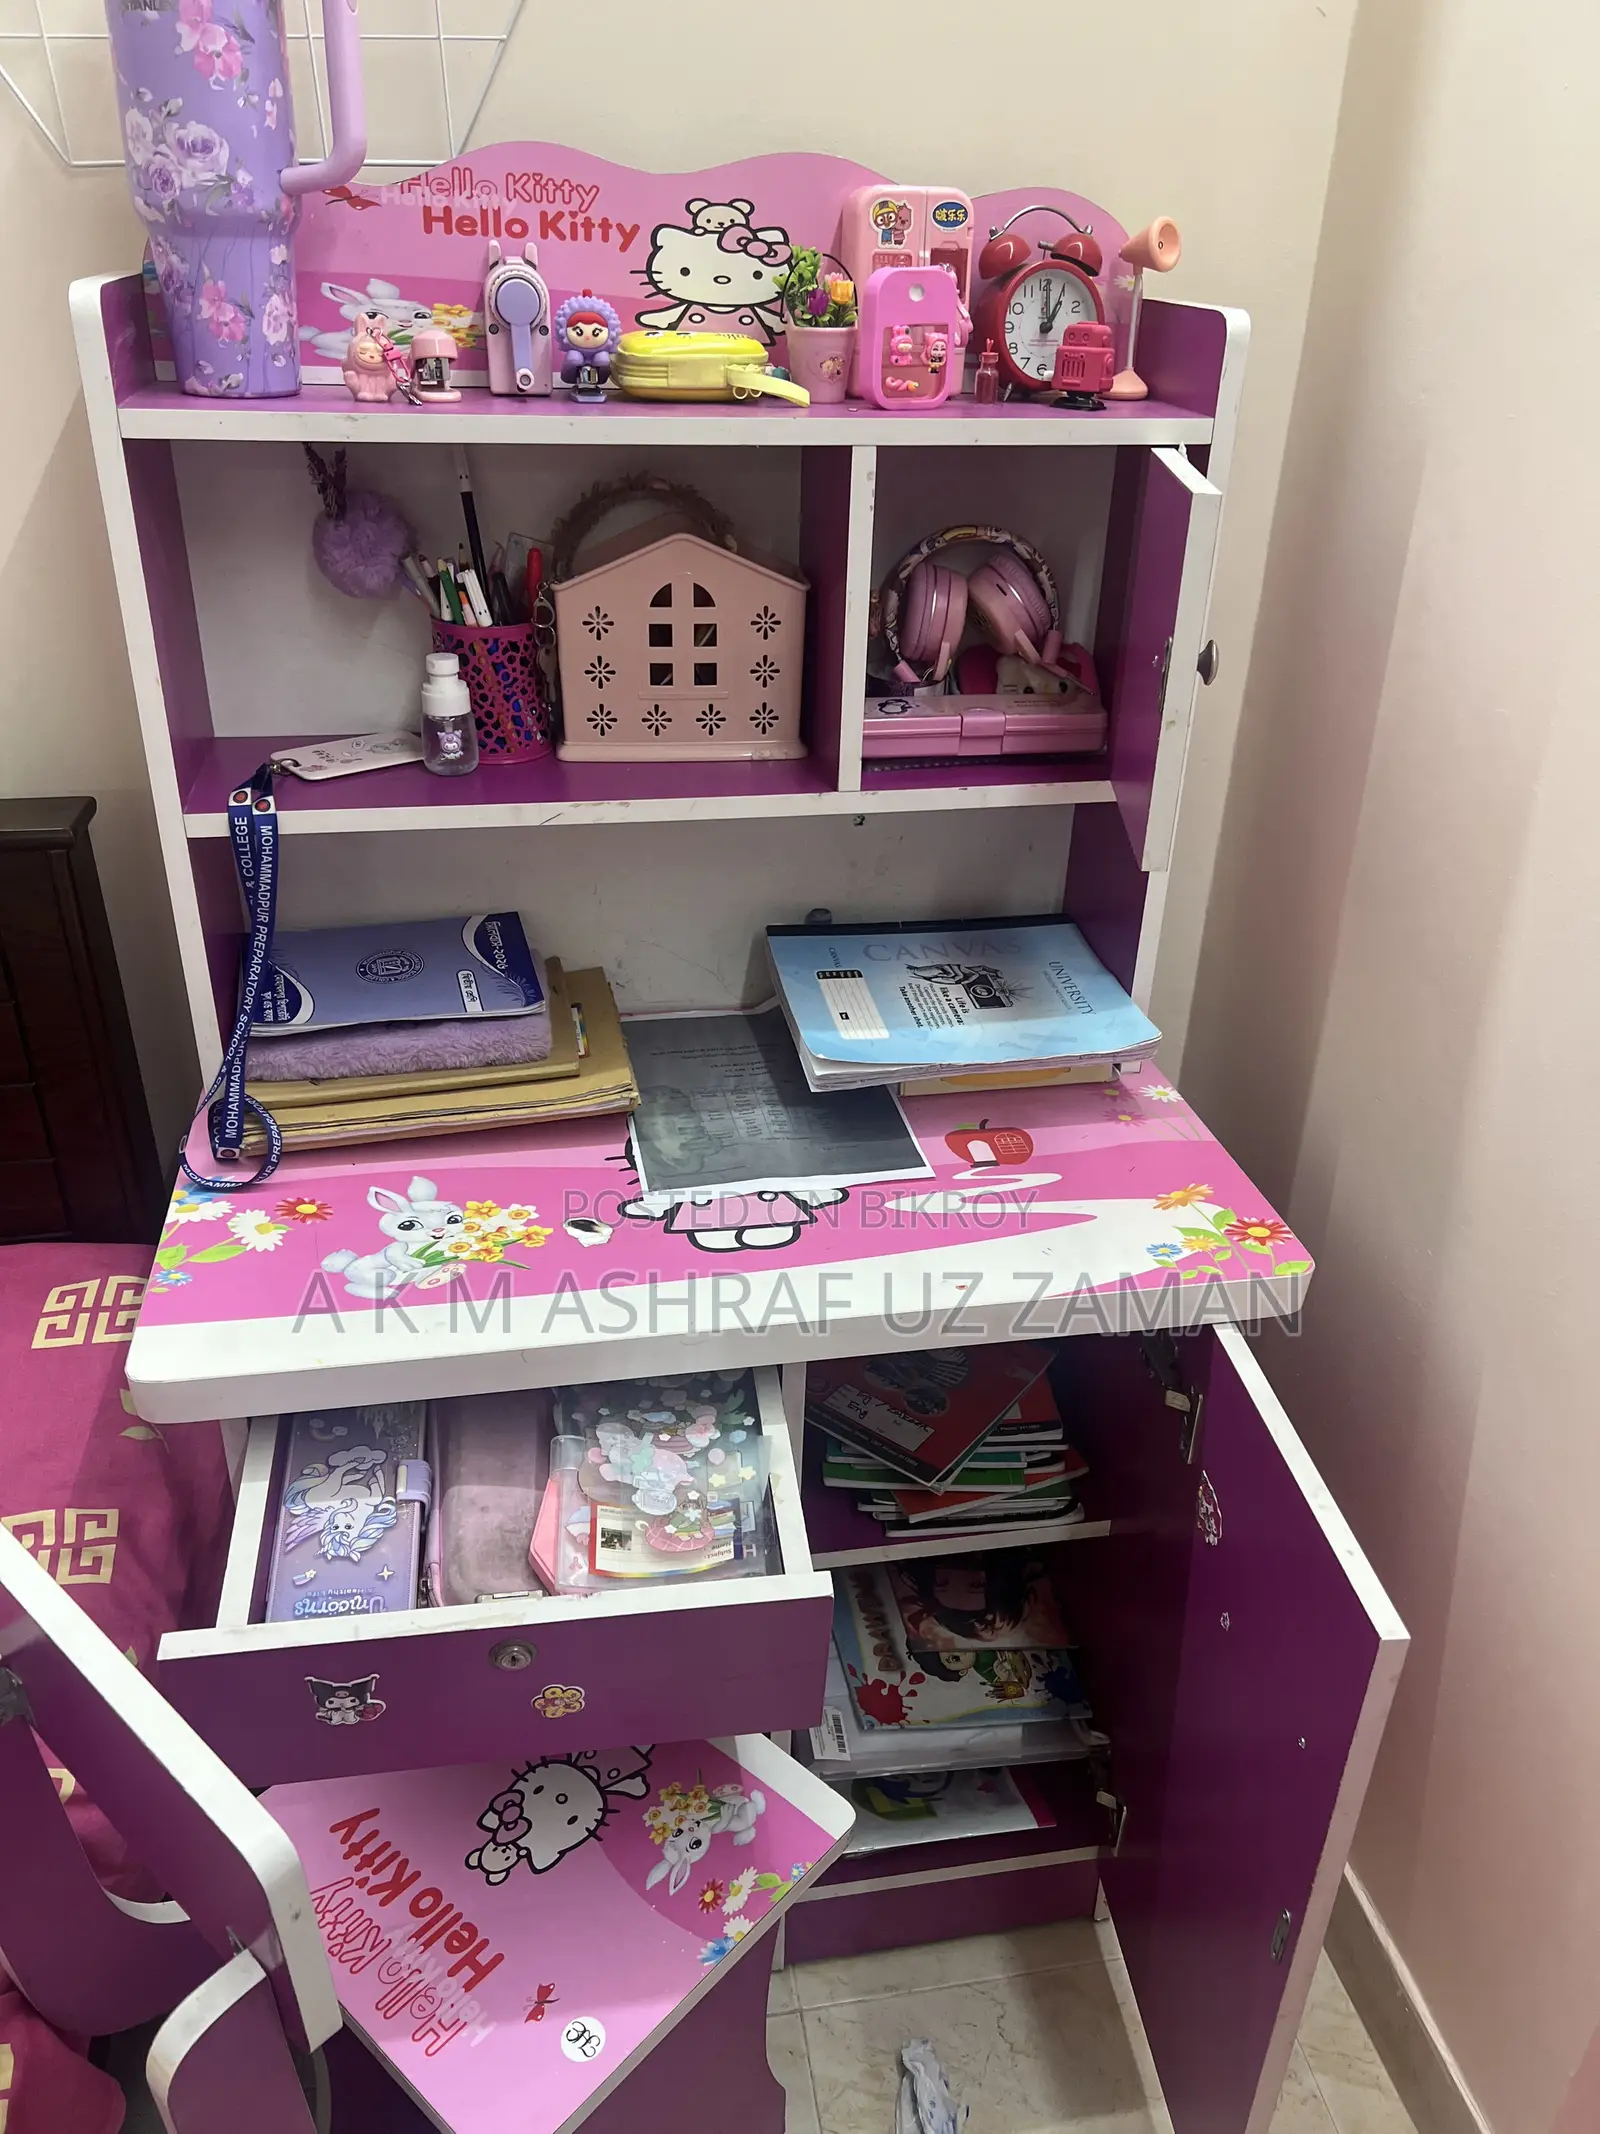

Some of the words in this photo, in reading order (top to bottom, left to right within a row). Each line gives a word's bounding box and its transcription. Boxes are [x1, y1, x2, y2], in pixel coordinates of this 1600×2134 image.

[401, 167, 498, 200] Hello
[505, 172, 600, 213] Kitty
[422, 205, 529, 239] Hello
[539, 210, 641, 253] Kitty
[1008, 302, 1024, 315] 10
[1023, 285, 1034, 298] 11
[1071, 300, 1081, 313] 2
[1004, 321, 1015, 333] 9
[1008, 342, 1019, 355] 8
[1020, 357, 1031, 370] 7
[234, 816, 255, 877] COLLEGE
[257, 825, 273, 923] MOHAMMADPUR
[243, 925, 268, 1013] PREPARATORY
[862, 936, 1022, 962] CANVAS
[899, 986, 909, 997] Take
[903, 997, 918, 1016] another
[954, 997, 966, 1009] Life
[1048, 961, 1097, 1015] UNIVERSITY
[225, 1014, 248, 1061] SCHOOL
[329, 1808, 422, 1908] Kitty
[310, 1877, 392, 1975] Kitty
[408, 1887, 505, 1993] Hello
[375, 1954, 468, 2058] Hello
